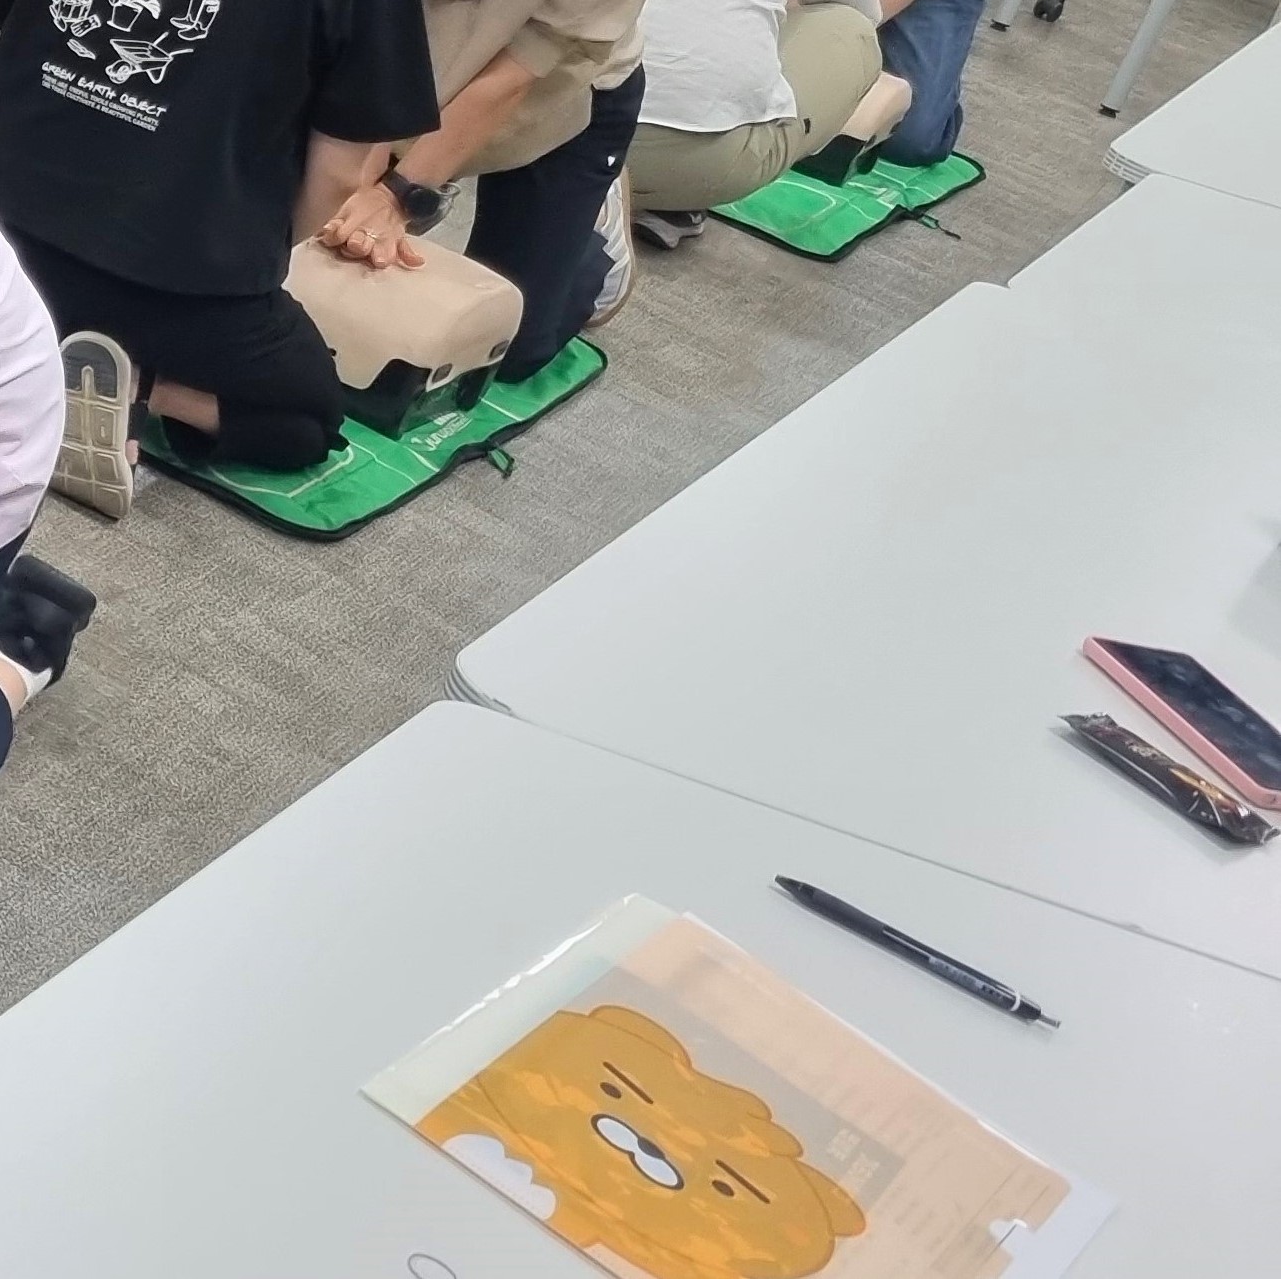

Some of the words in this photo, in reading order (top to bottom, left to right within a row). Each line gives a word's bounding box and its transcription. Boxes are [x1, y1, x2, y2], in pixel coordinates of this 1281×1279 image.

[41, 61, 76, 82] GREEN
[77, 77, 117, 100] EARTH
[119, 93, 167, 117] OBJECT
